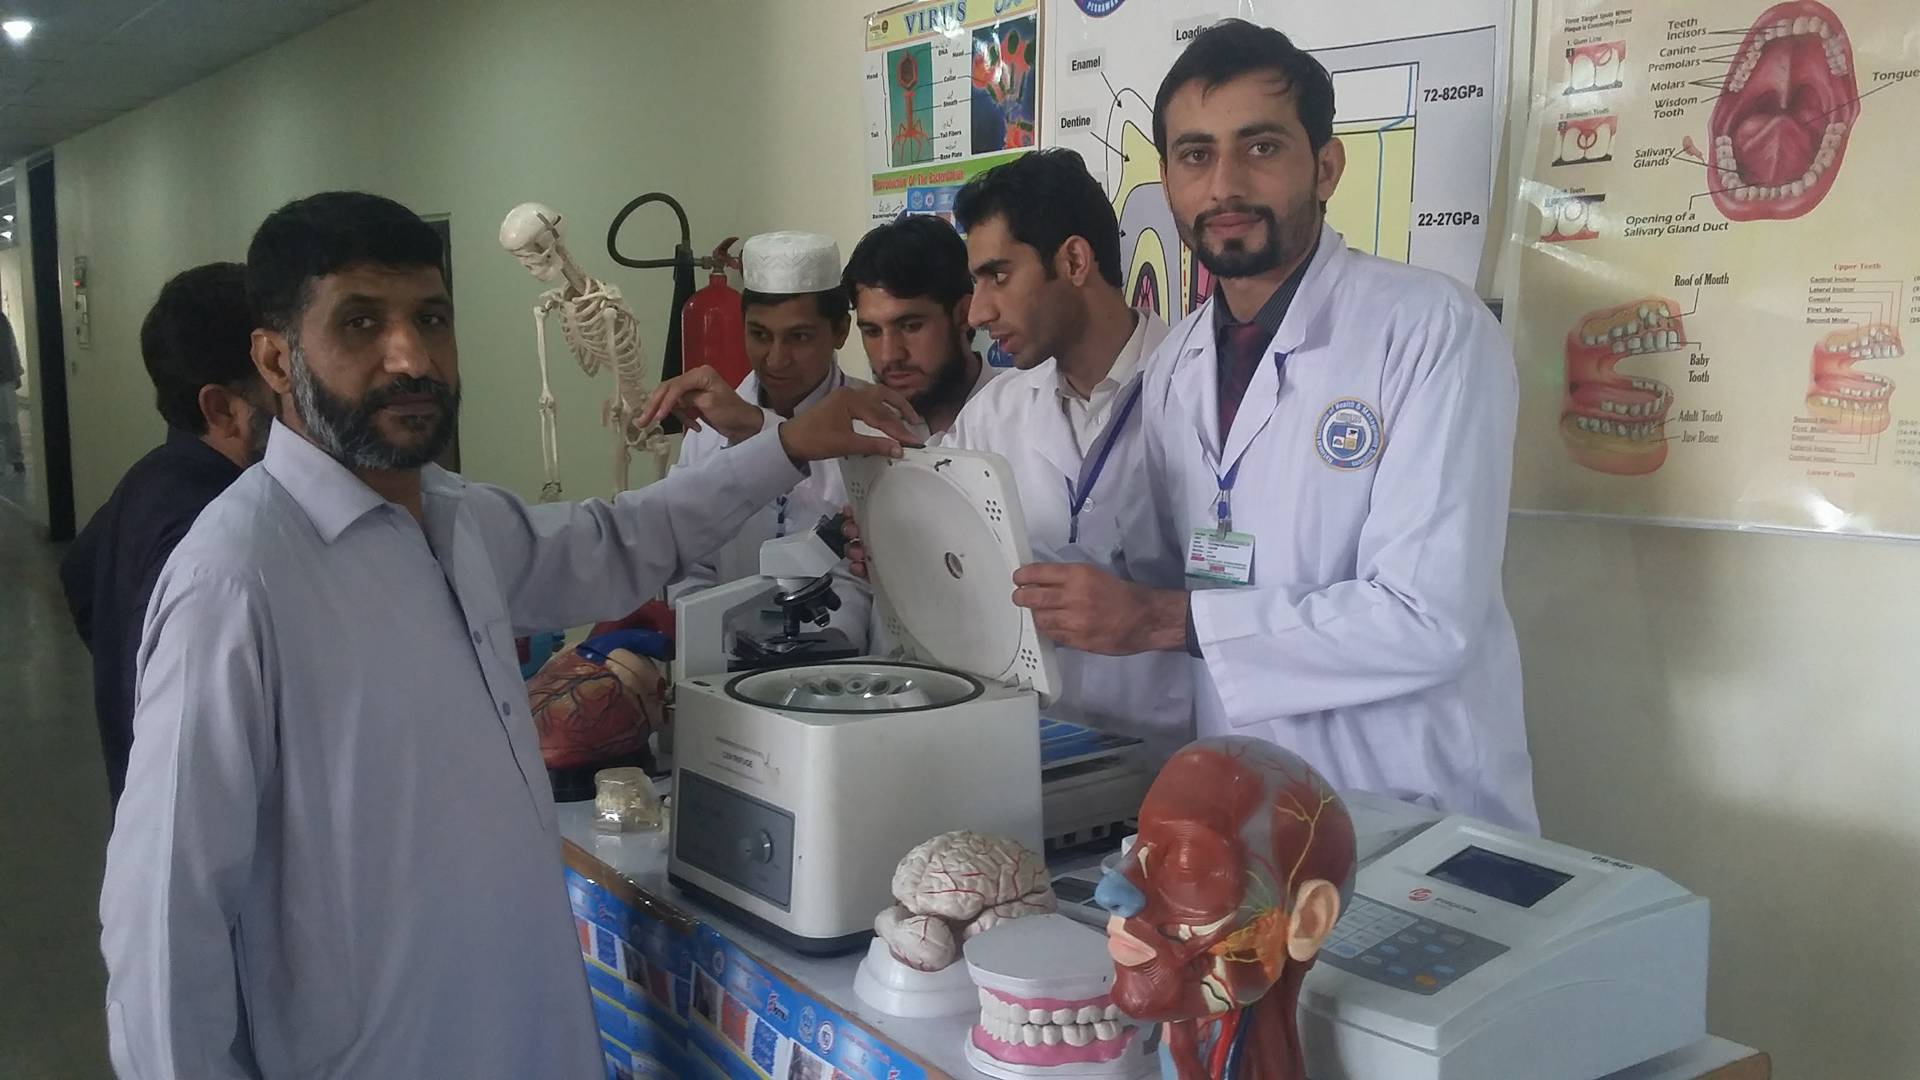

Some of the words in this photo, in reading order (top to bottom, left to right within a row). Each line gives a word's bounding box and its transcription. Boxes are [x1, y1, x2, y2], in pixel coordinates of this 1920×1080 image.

[904, 0, 967, 35] VIRUS
[1668, 18, 1698, 30] Teeth
[1176, 25, 1214, 41] Loadin
[1667, 28, 1707, 40] Incisors
[1660, 45, 1697, 57] Canine
[1071, 56, 1101, 71] Enamel
[1648, 58, 1700, 72] Premolars
[1872, 69, 1920, 81] Tongue
[1651, 80, 1686, 92] Molars
[1424, 84, 1484, 102] 72-82GPa
[1655, 97, 1698, 108] Wisdom
[1654, 108, 1684, 119] Tooth
[1060, 116, 1091, 128] Dentine
[1635, 147, 1675, 158] Salivary
[1633, 157, 1670, 168] Glands
[1418, 211, 1480, 226] 22-27GPa
[1626, 214, 1672, 227] Opening
[1675, 212, 1687, 221] of
[1689, 213, 1696, 221] a
[1624, 226, 1664, 237] Salivary
[1667, 223, 1700, 234] Gland
[1702, 222, 1729, 232] Duct
[1674, 273, 1694, 287] Roof
[1694, 273, 1704, 286] of
[1704, 272, 1730, 285] Mouth
[1689, 353, 1710, 368] Baby
[1688, 370, 1710, 383] Tooth
[1677, 409, 1699, 422] Adult
[1701, 409, 1723, 422] Tooth
[1681, 430, 1698, 443] Jaw
